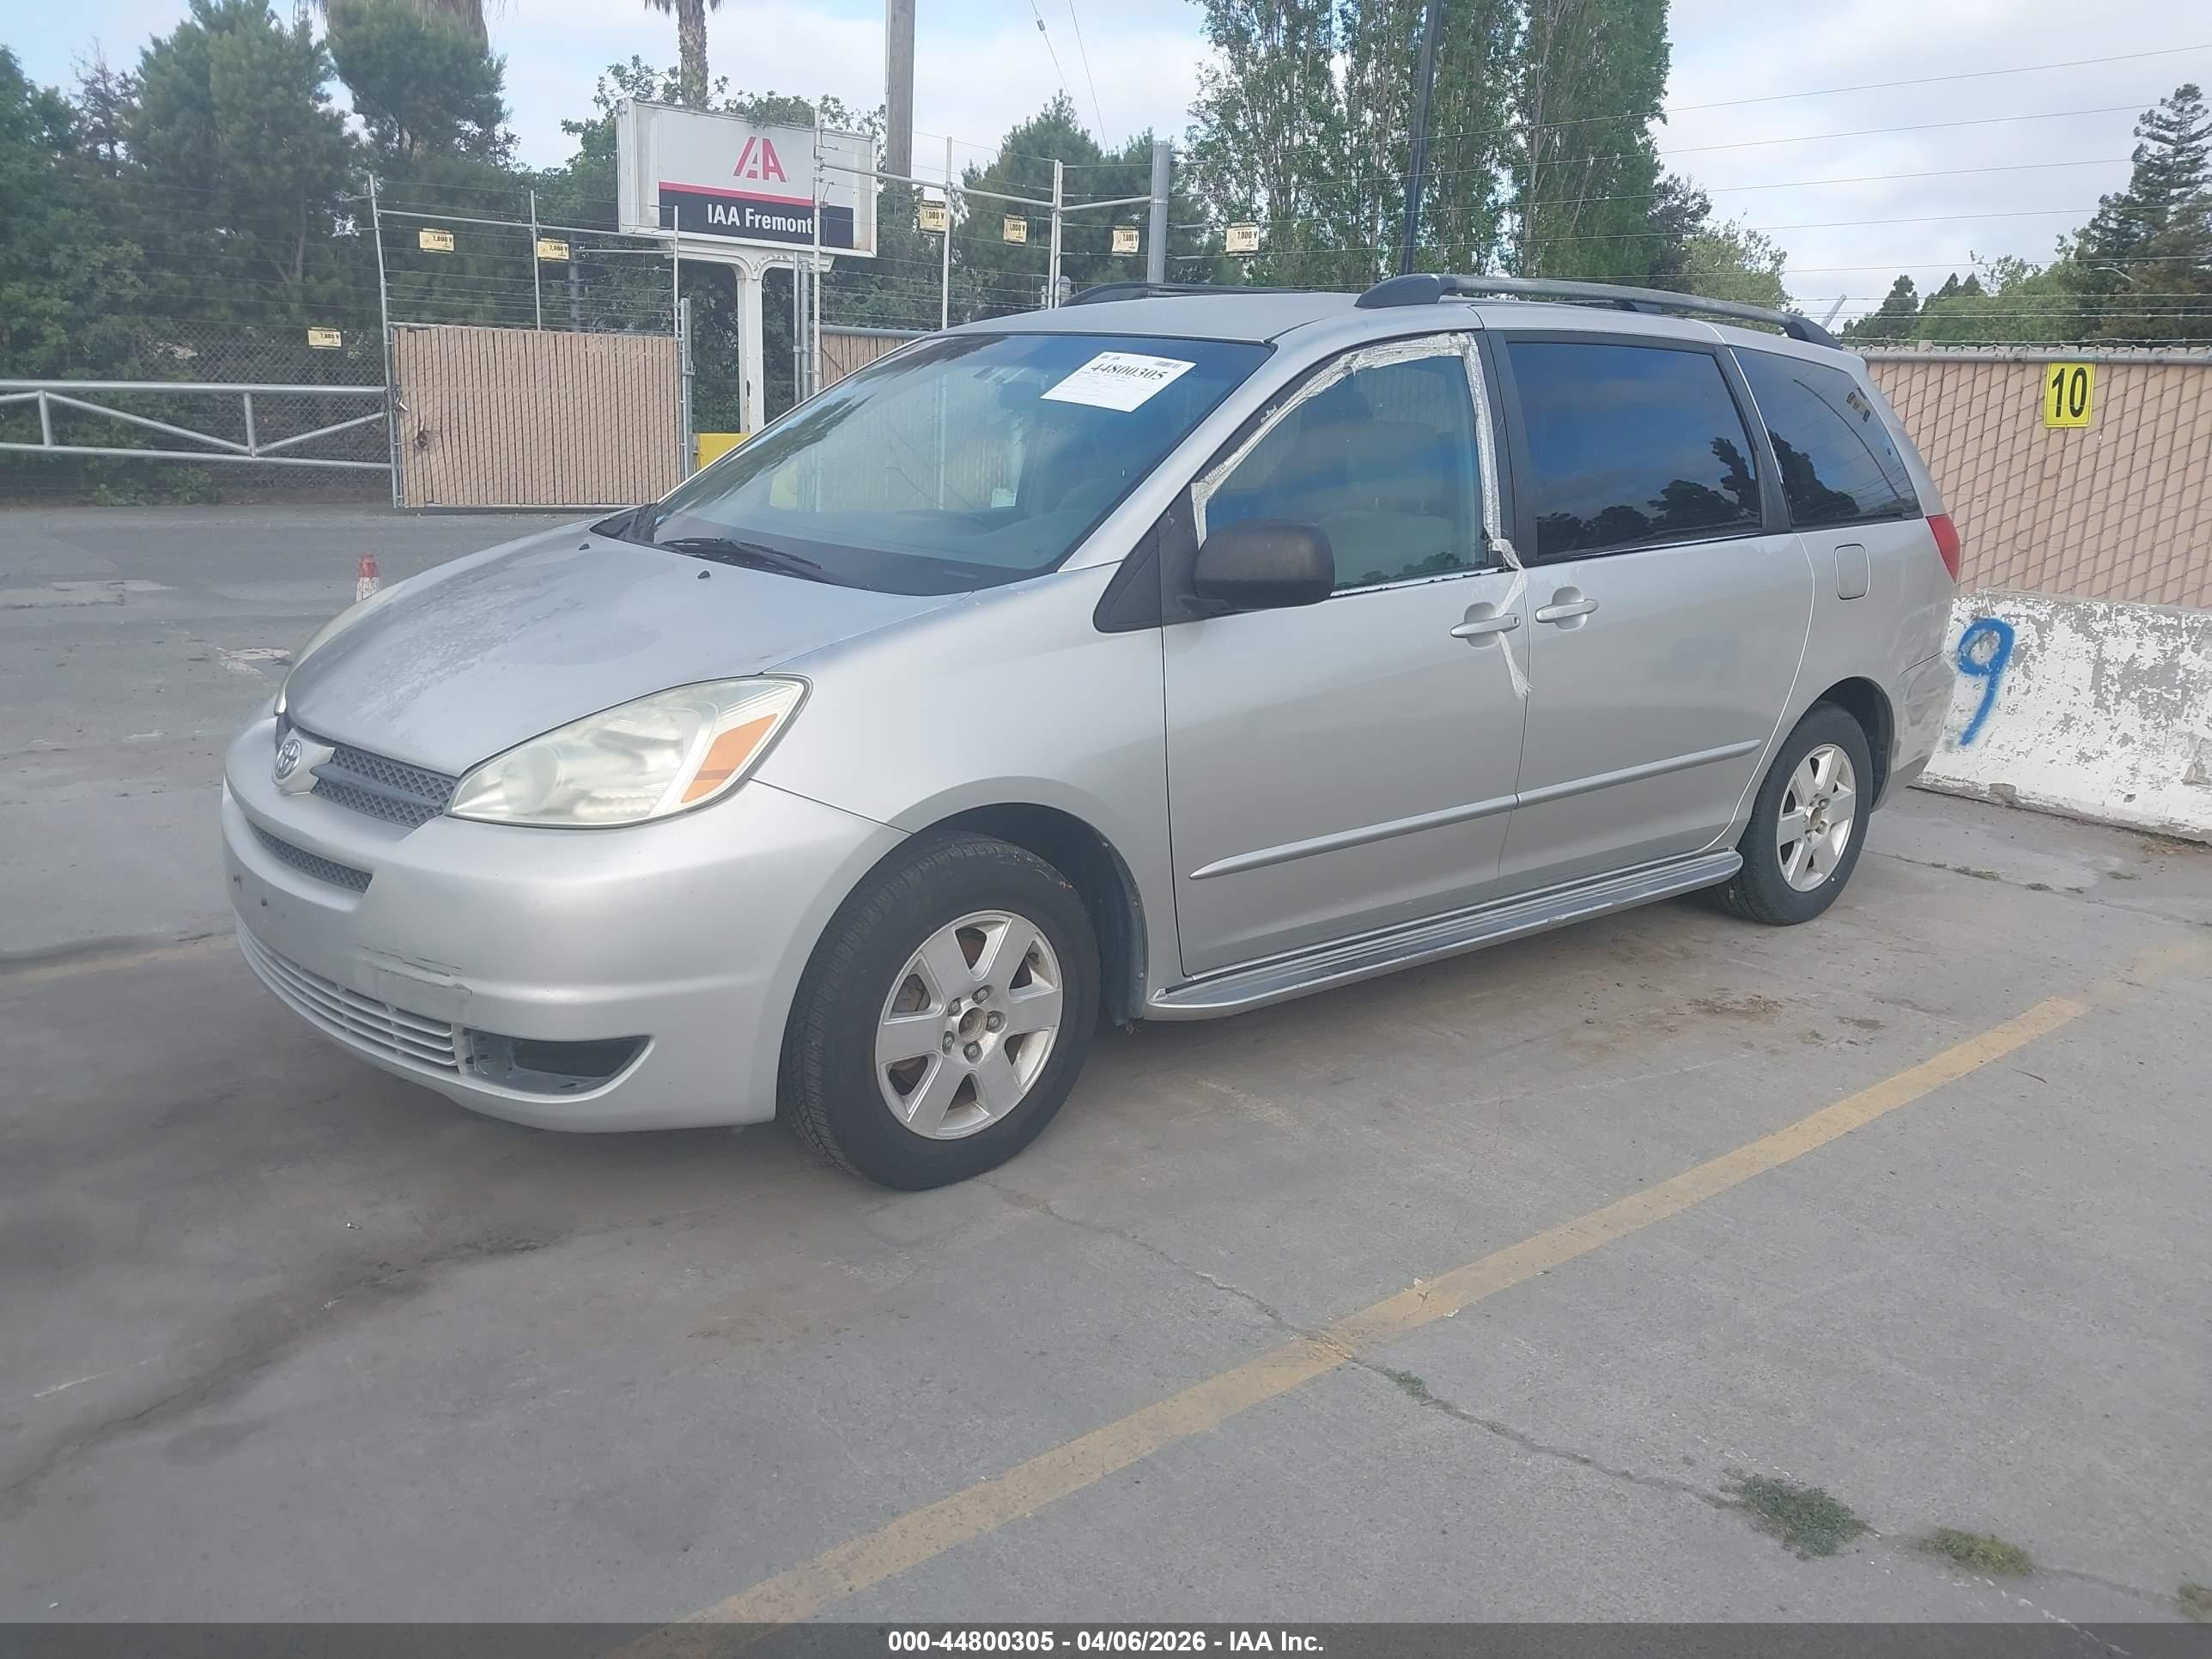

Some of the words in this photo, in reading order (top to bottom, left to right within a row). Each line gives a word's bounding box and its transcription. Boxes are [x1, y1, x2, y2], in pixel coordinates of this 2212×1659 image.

[708, 203, 741, 227] IAA
[745, 208, 813, 234] Fremont
[940, 212, 945, 221] V
[1090, 362, 1169, 380] 44800305
[2051, 367, 2087, 418] 10
[1957, 617, 2015, 747] 9
